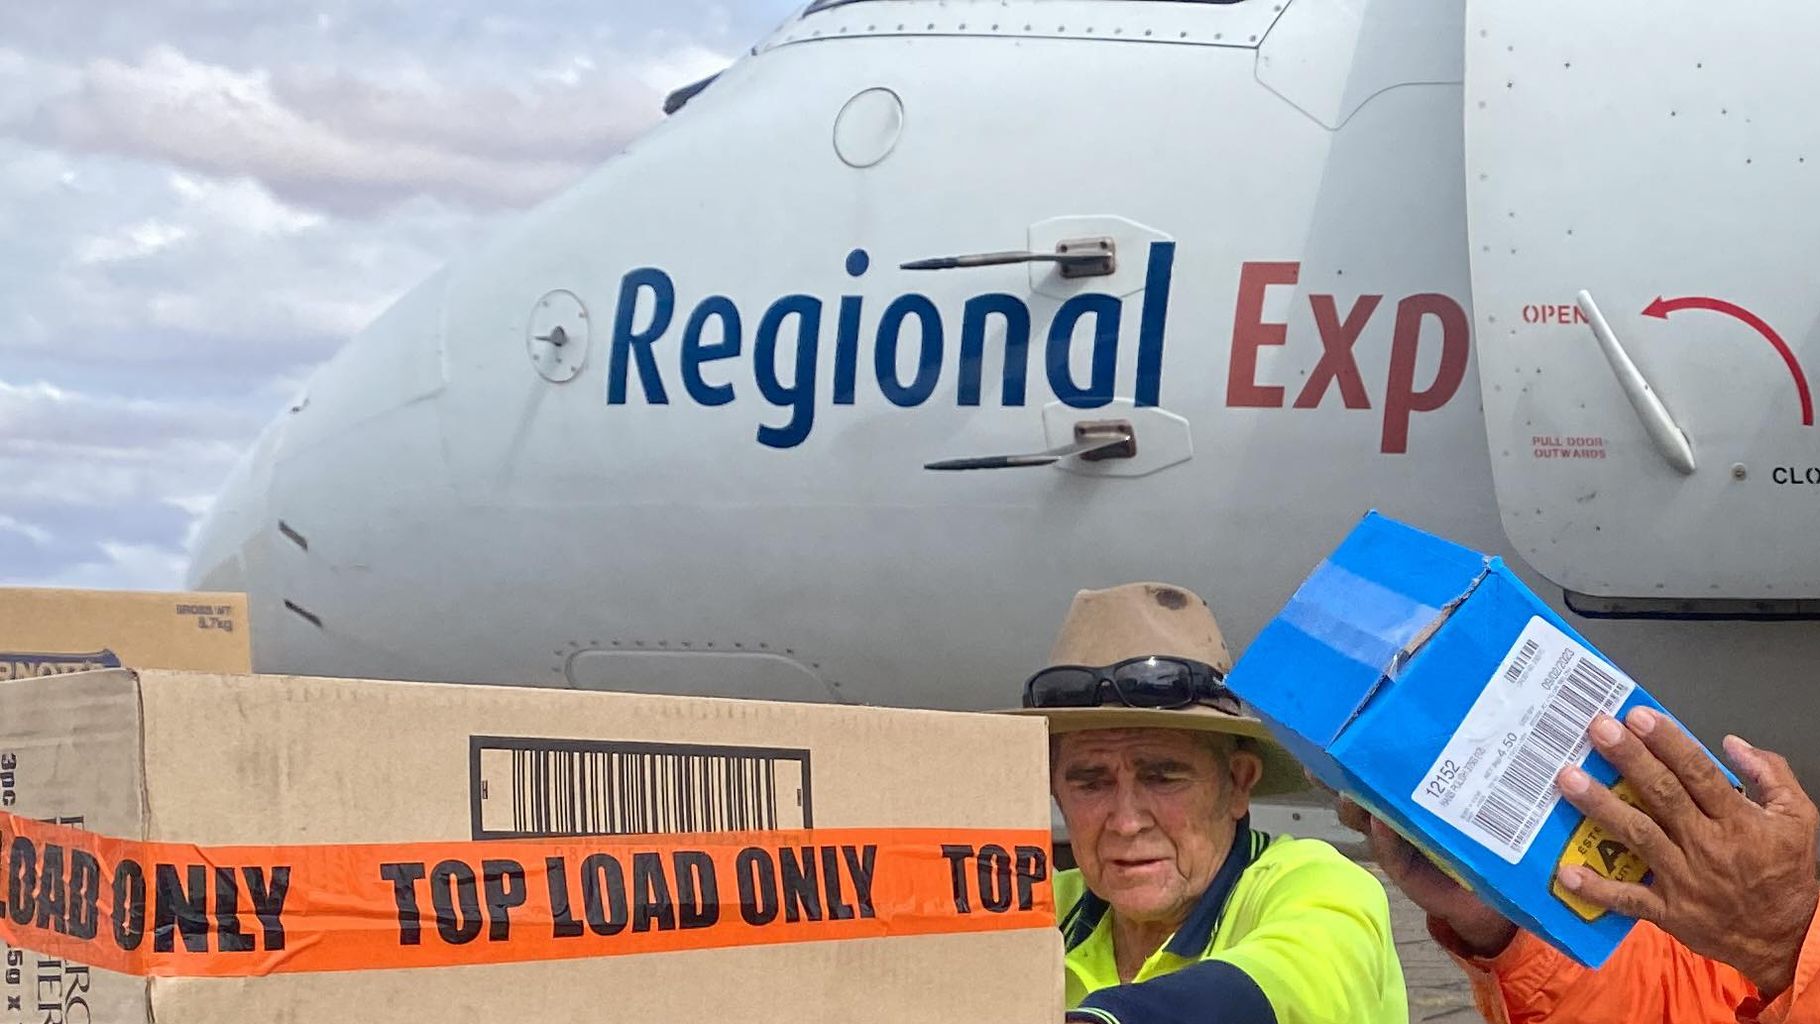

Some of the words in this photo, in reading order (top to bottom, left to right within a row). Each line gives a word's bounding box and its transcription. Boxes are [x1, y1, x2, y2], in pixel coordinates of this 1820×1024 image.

[1522, 304, 1590, 325] OPEN
[607, 241, 1175, 448] Regional
[1225, 261, 1470, 453] Exp
[1532, 436, 1564, 447] PULL
[1534, 448, 1606, 459] OUTWARDS
[1426, 759, 1462, 800] 12152
[0, 831, 99, 941] OAD
[112, 858, 291, 953] ONLY
[381, 859, 528, 946] TOP
[544, 851, 720, 938] LOAD
[735, 844, 877, 925] ONLY
[941, 844, 1046, 914] TOP
